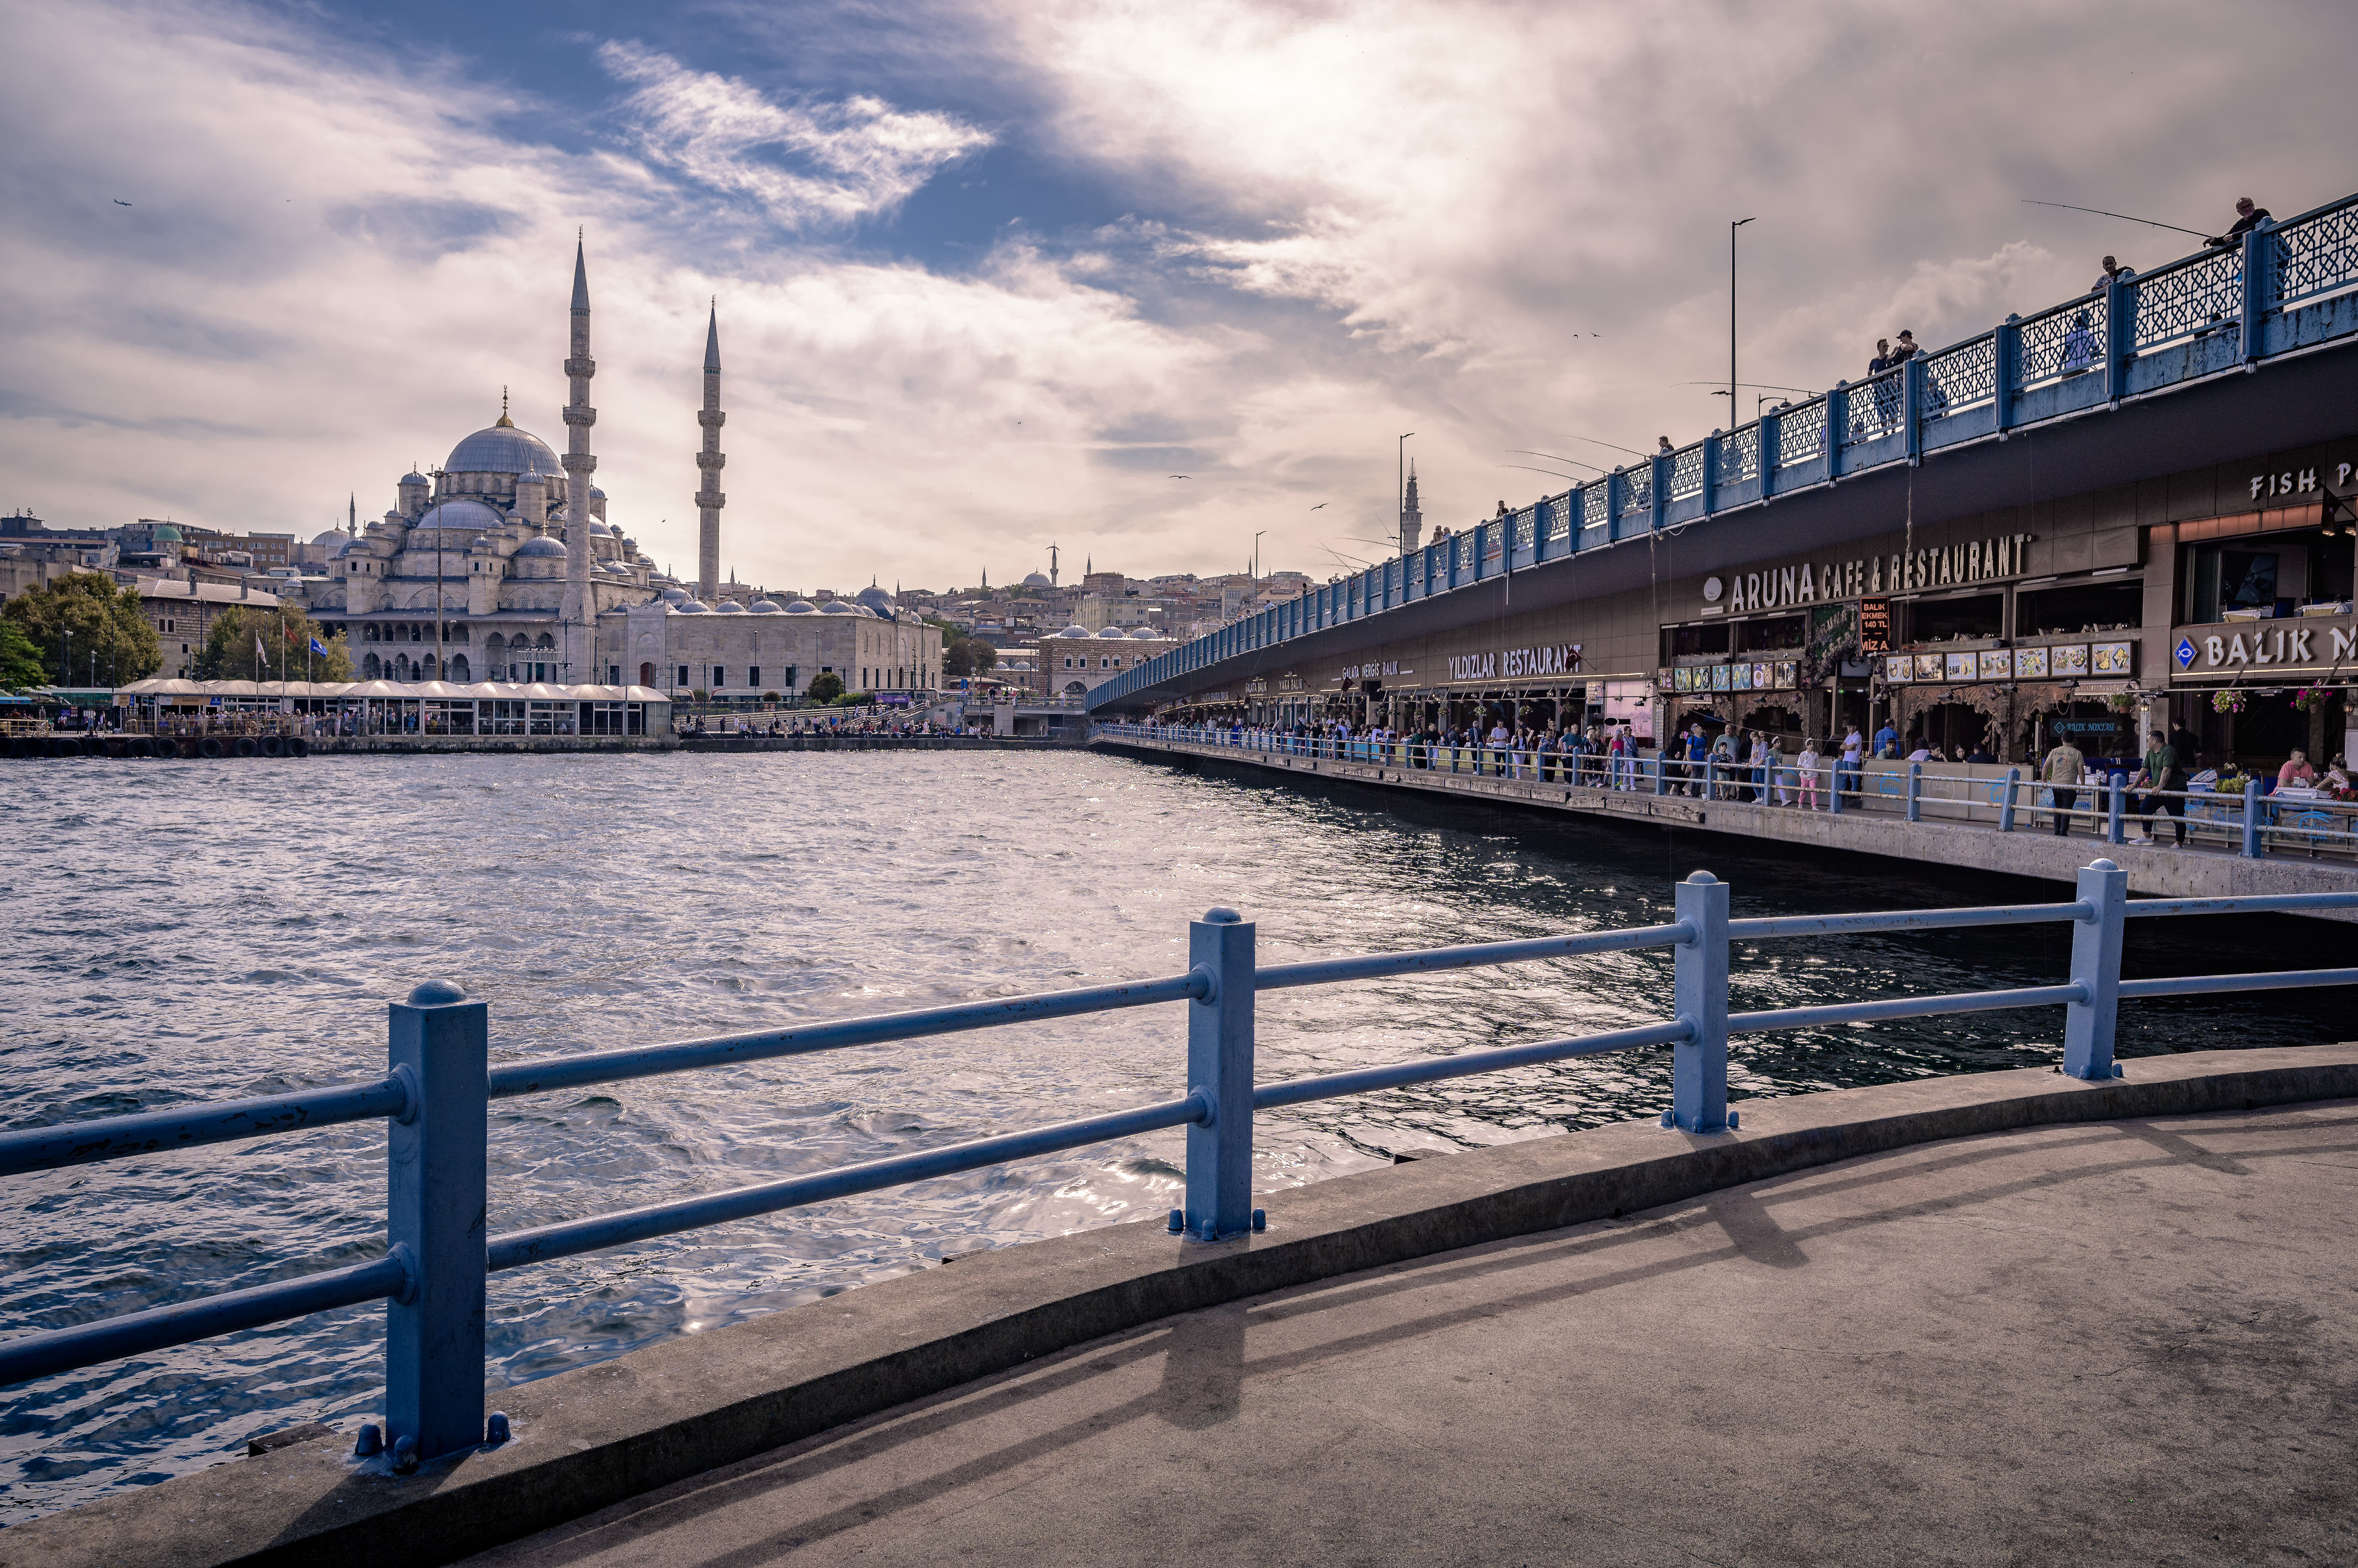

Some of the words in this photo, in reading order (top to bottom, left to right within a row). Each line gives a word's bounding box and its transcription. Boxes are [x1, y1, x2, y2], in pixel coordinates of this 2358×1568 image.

[2249, 467, 2316, 500] FISH
[1731, 563, 1814, 612] ARUNA
[1822, 562, 1863, 599] CAFE
[1872, 556, 1880, 592] &
[1890, 534, 2025, 591] RESTAURANT
[2204, 628, 2314, 666] BALIK
[1343, 665, 1360, 680] GALATA
[1362, 659, 1379, 678] NERGİS
[1382, 660, 1398, 676] BALIK
[1448, 652, 1495, 680] YILDIZLAR
[1245, 682, 1257, 692] GALATA
[1258, 681, 1267, 692] BALIK
[1279, 679, 1289, 690] YAKA
[1291, 678, 1303, 690] BALIK
